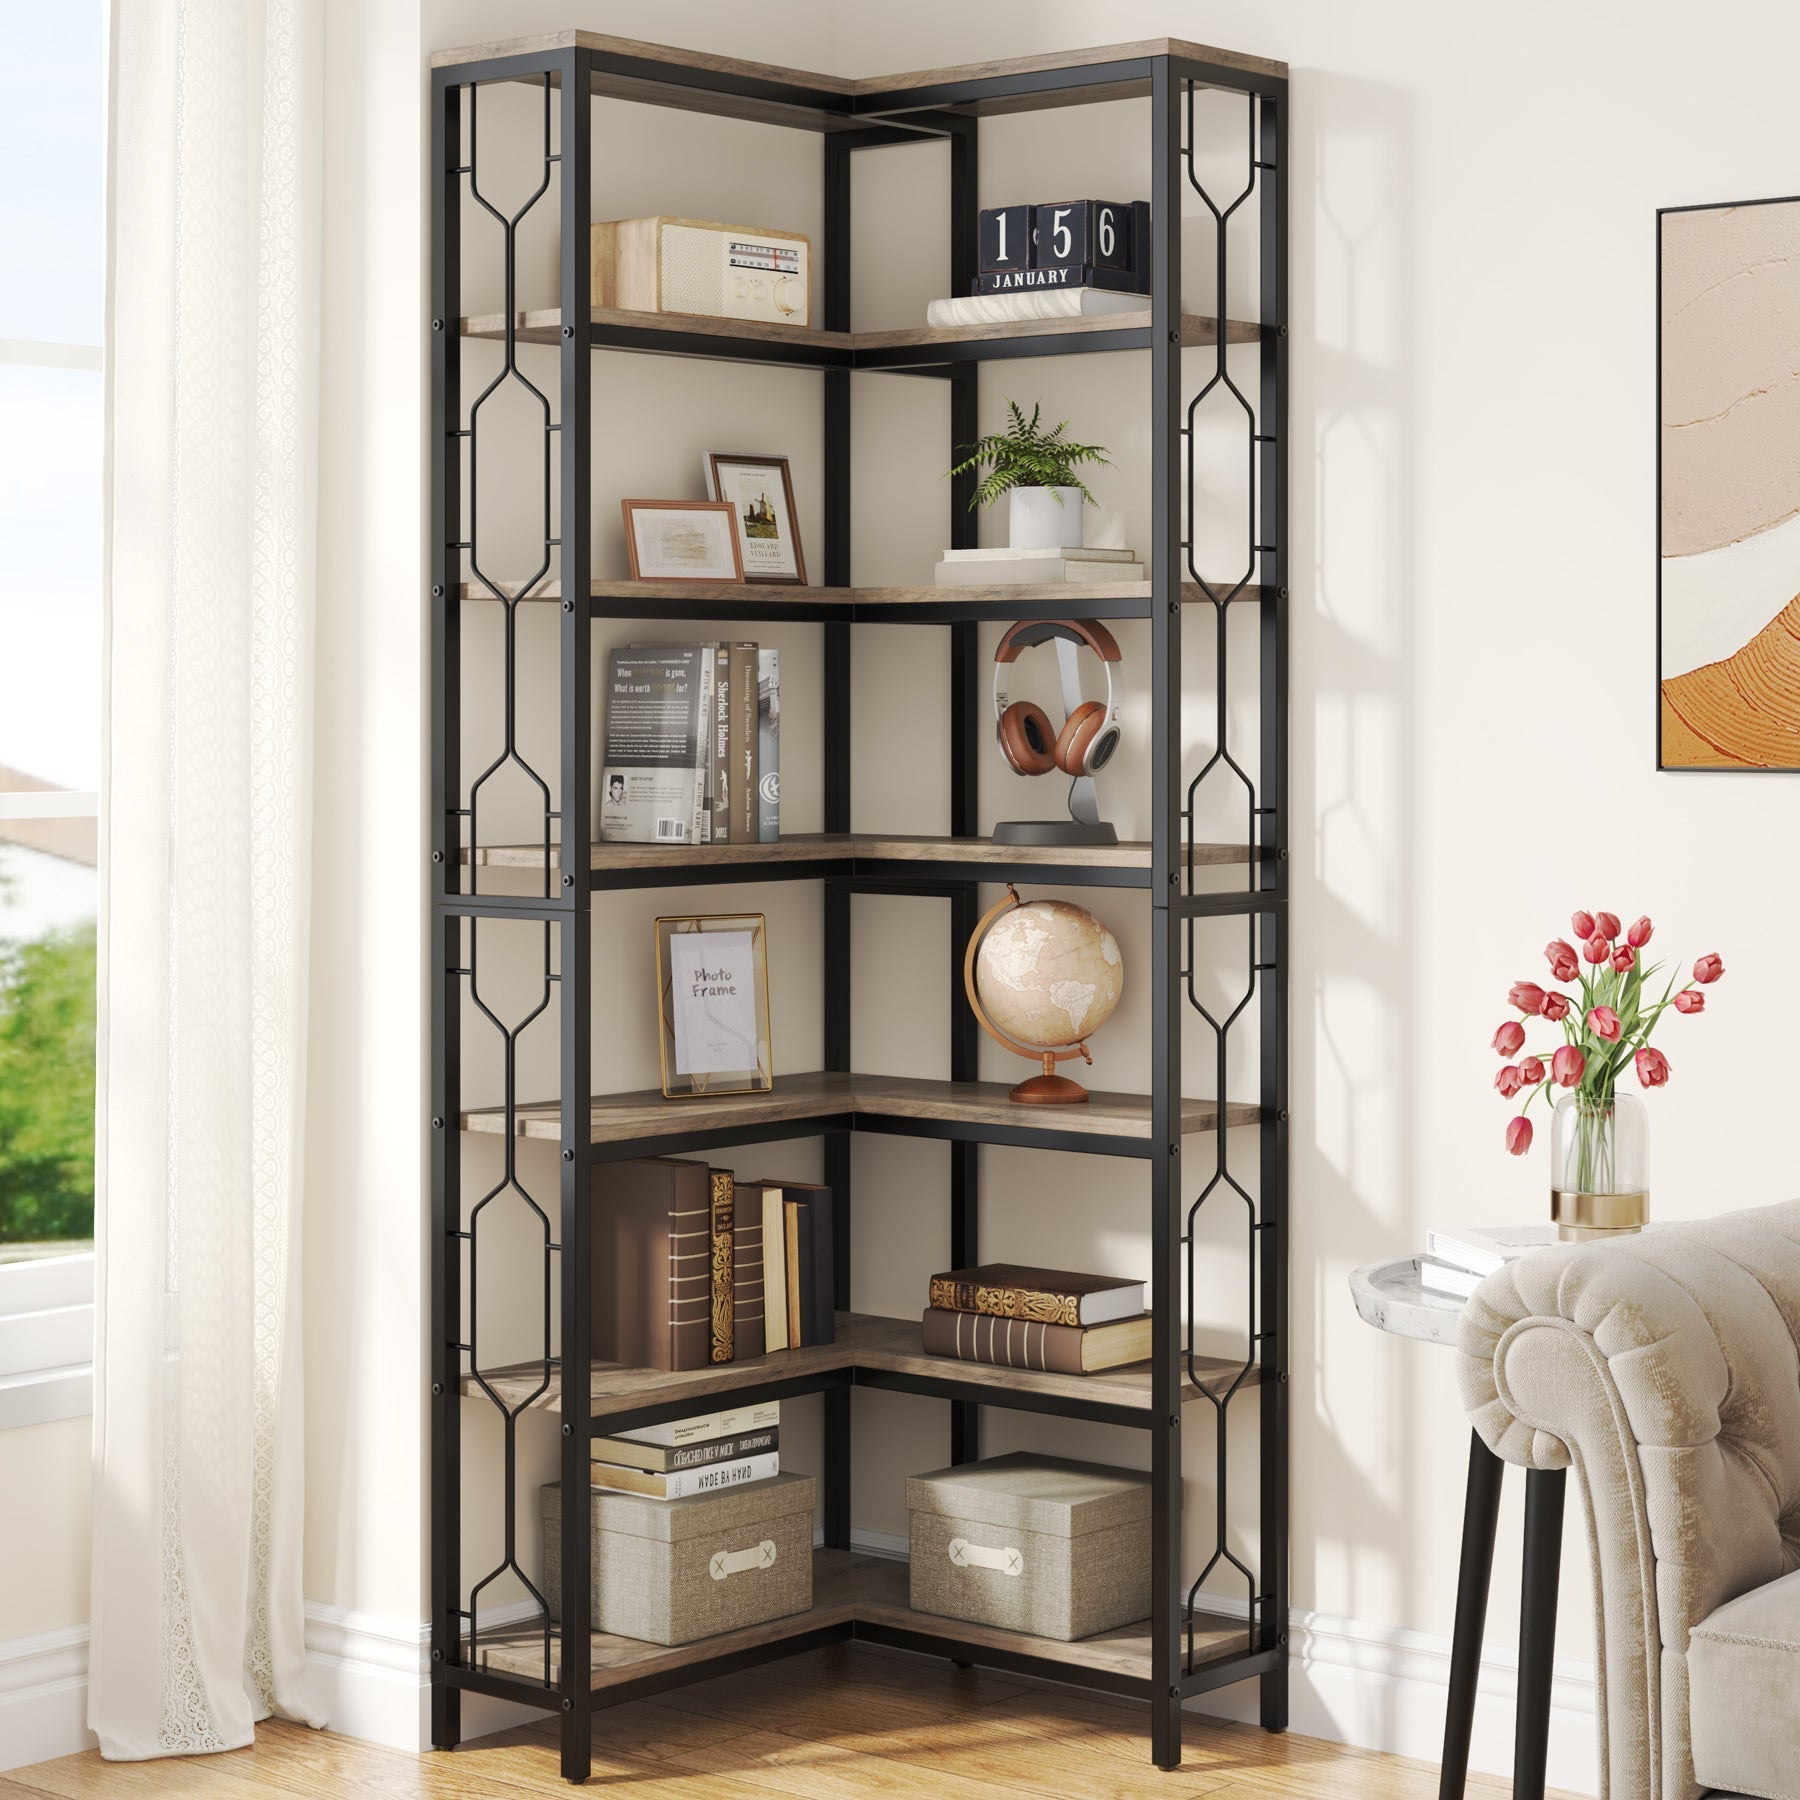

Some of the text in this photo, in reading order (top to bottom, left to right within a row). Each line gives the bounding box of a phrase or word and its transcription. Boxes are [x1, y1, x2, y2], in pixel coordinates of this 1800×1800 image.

[995, 208, 1115, 261] 1 5 6
[992, 268, 1069, 289] JANUARY
[617, 668, 632, 678] When
[665, 668, 671, 677] is
[671, 669, 687, 679] gone,
[614, 683, 628, 693] What
[628, 683, 634, 693] is
[635, 683, 651, 693] worth
[676, 683, 688, 693] for?
[744, 665, 752, 702] Dreaming
[745, 703, 752, 711] of
[717, 681, 729, 758] Sherlock Holmes
[694, 967, 733, 982] Photo
[692, 984, 737, 997] Frame
